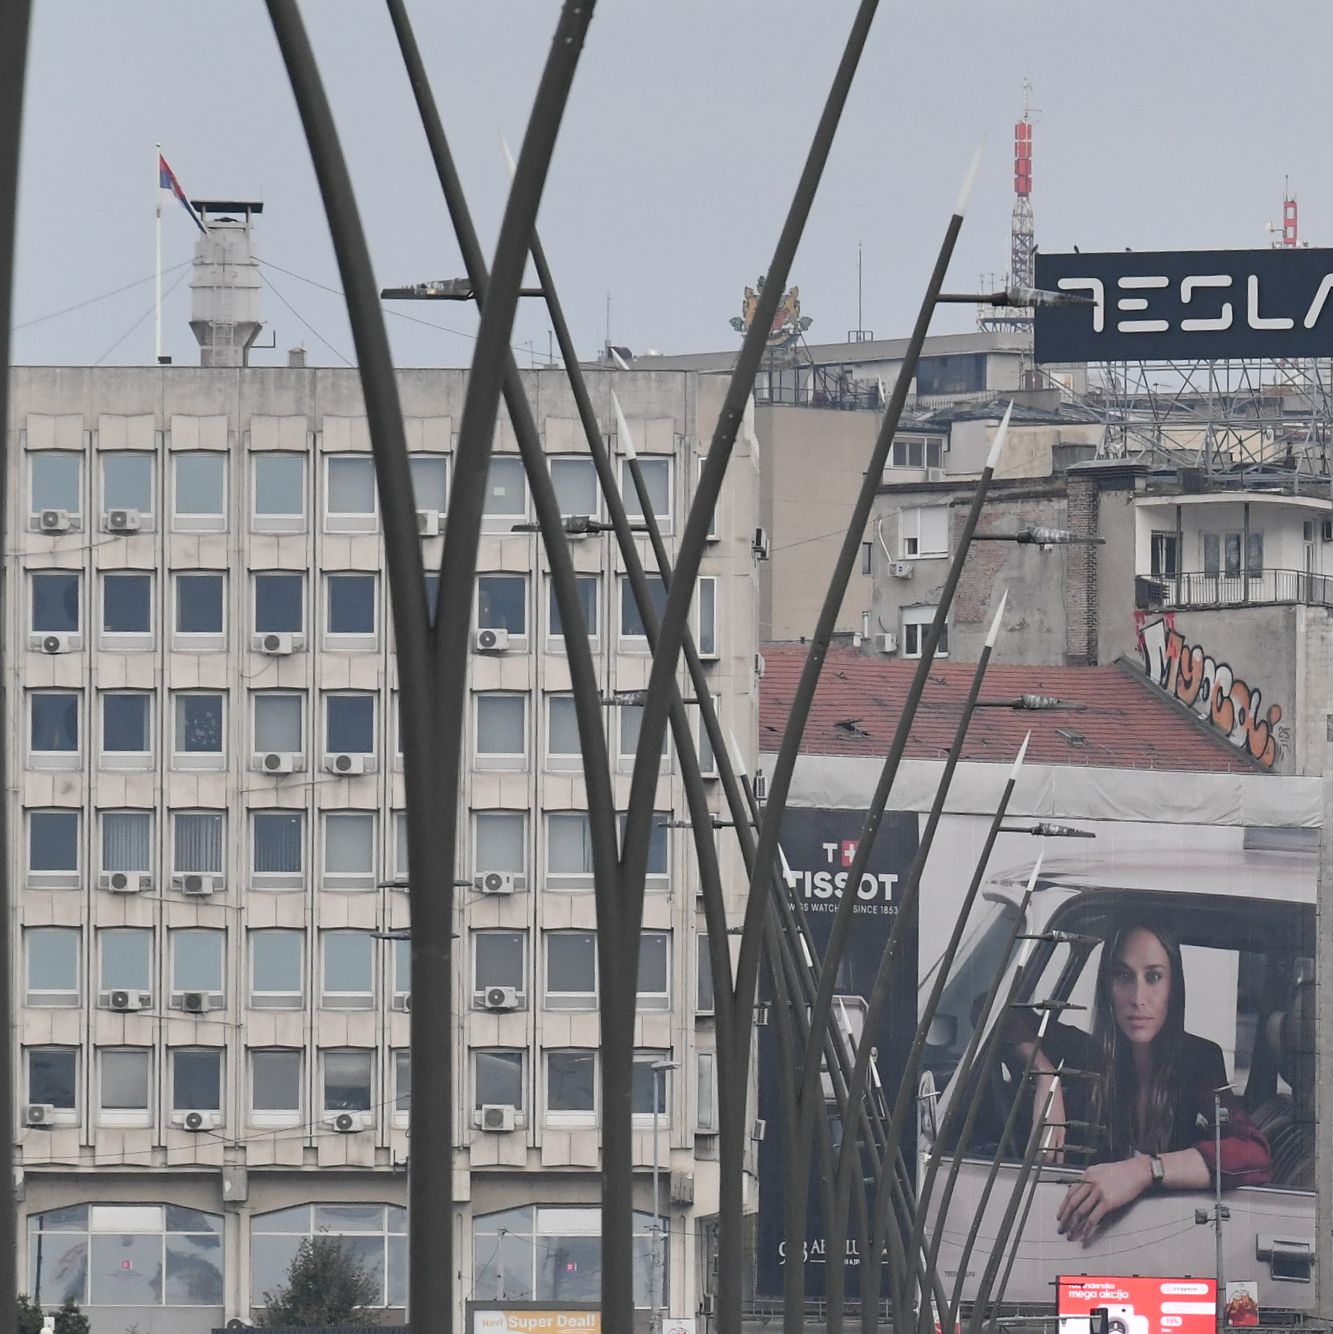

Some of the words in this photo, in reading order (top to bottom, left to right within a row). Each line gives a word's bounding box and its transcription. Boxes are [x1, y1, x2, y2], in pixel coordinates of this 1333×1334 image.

[853, 904, 878, 915] SINCE
[880, 906, 899, 915] 1853
[1068, 1290, 1097, 1300] mega
[1099, 1289, 1129, 1300] akcija
[508, 1315, 553, 1331] Super
[557, 1313, 596, 1327] Deal!
